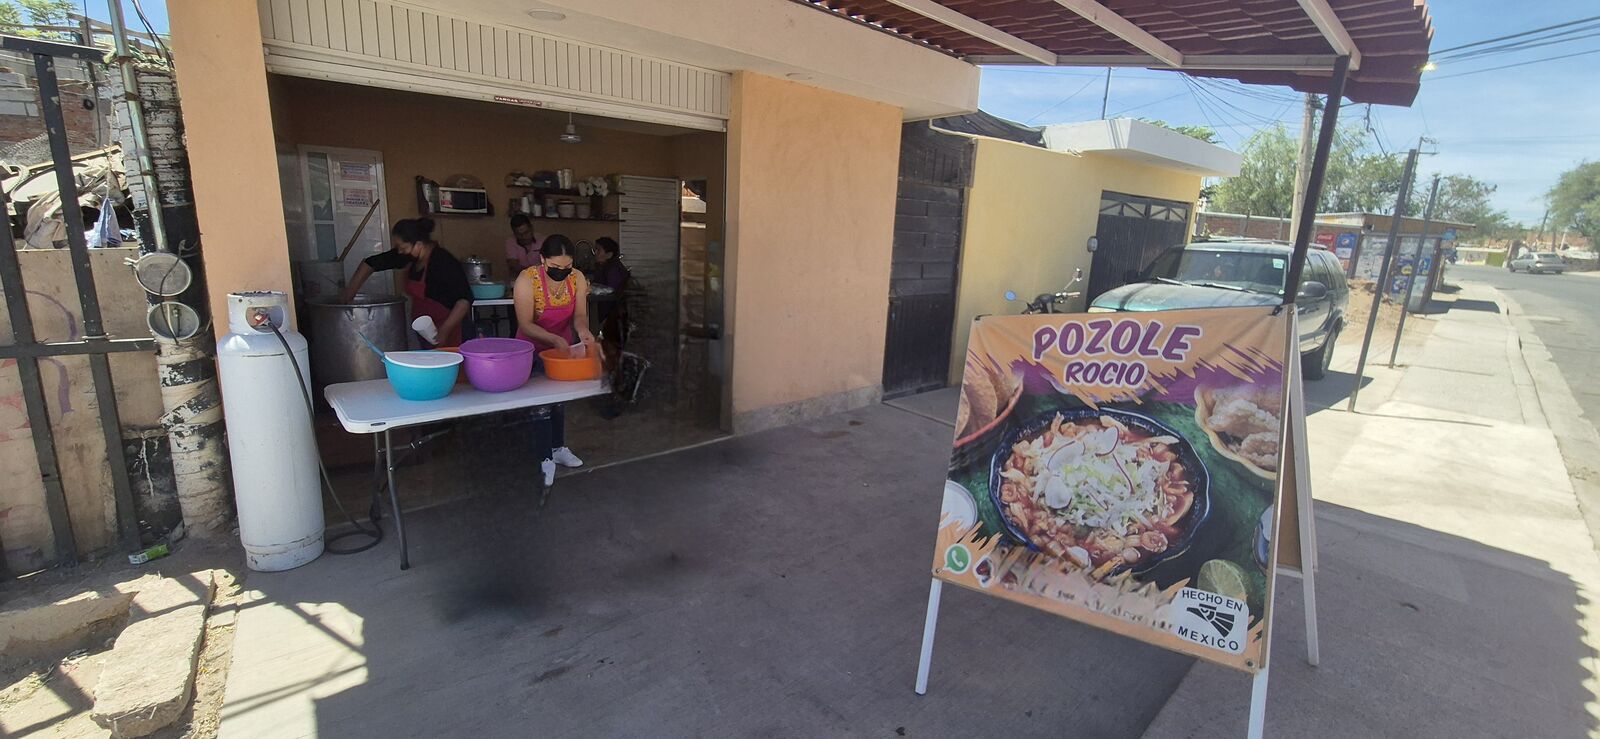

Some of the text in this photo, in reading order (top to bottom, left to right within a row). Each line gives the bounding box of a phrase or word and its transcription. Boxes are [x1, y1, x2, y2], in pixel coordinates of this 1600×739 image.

[1033, 319, 1201, 361] POZOLE
[1065, 361, 1146, 386] ROCIO
[1182, 589, 1243, 612] HECHO EN
[1177, 625, 1239, 651] MEXICO
